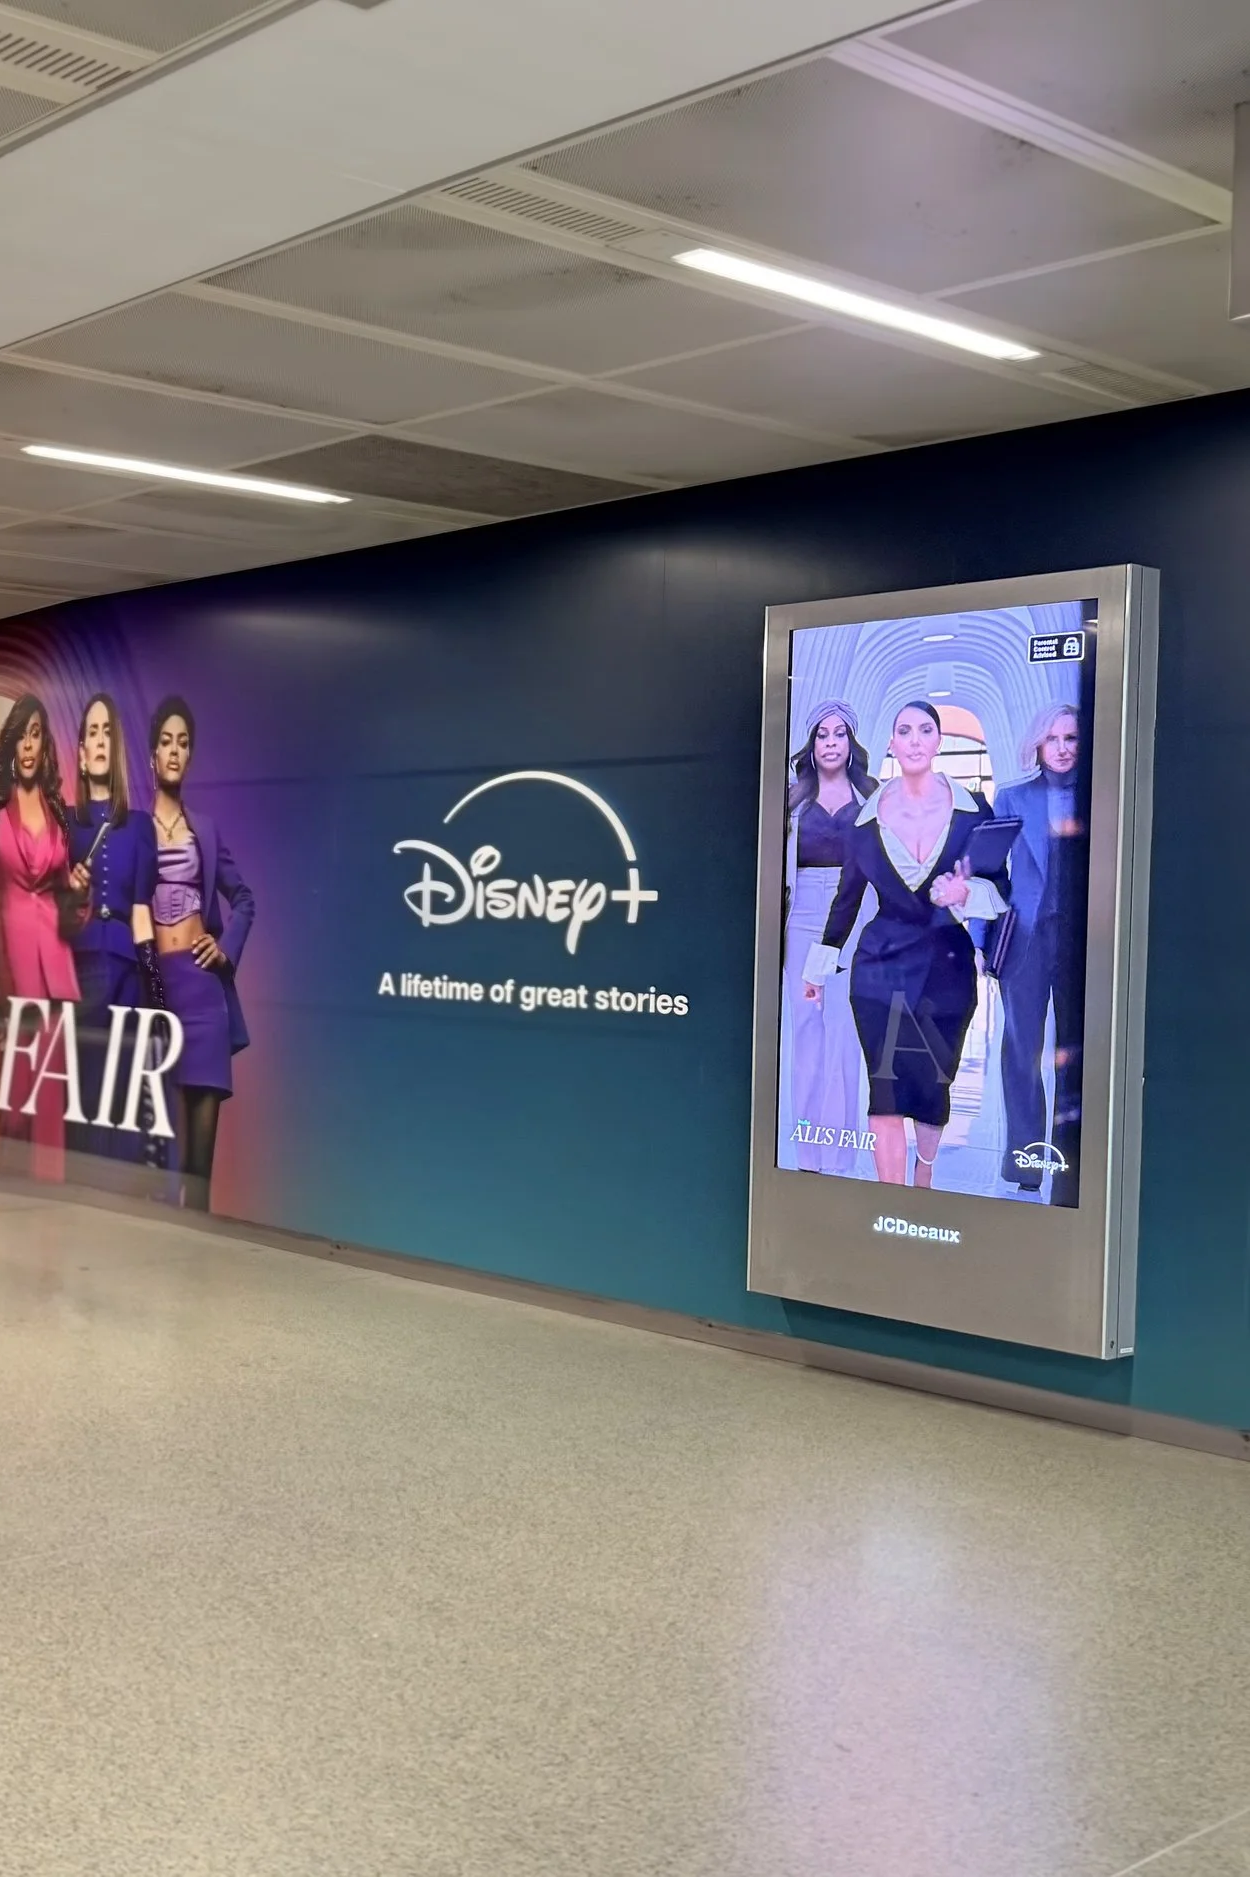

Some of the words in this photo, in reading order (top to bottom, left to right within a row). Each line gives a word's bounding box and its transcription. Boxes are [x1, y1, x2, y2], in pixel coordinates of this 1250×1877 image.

[393, 839, 658, 954] Disney+
[378, 972, 395, 996] A
[401, 973, 484, 1001] lifetime
[489, 979, 515, 1004] of
[520, 985, 588, 1012] great
[594, 987, 689, 1016] stories
[790, 1124, 835, 1146] ALL'S
[838, 1129, 877, 1151] FAIR
[873, 1215, 960, 1244] JCDecaux
